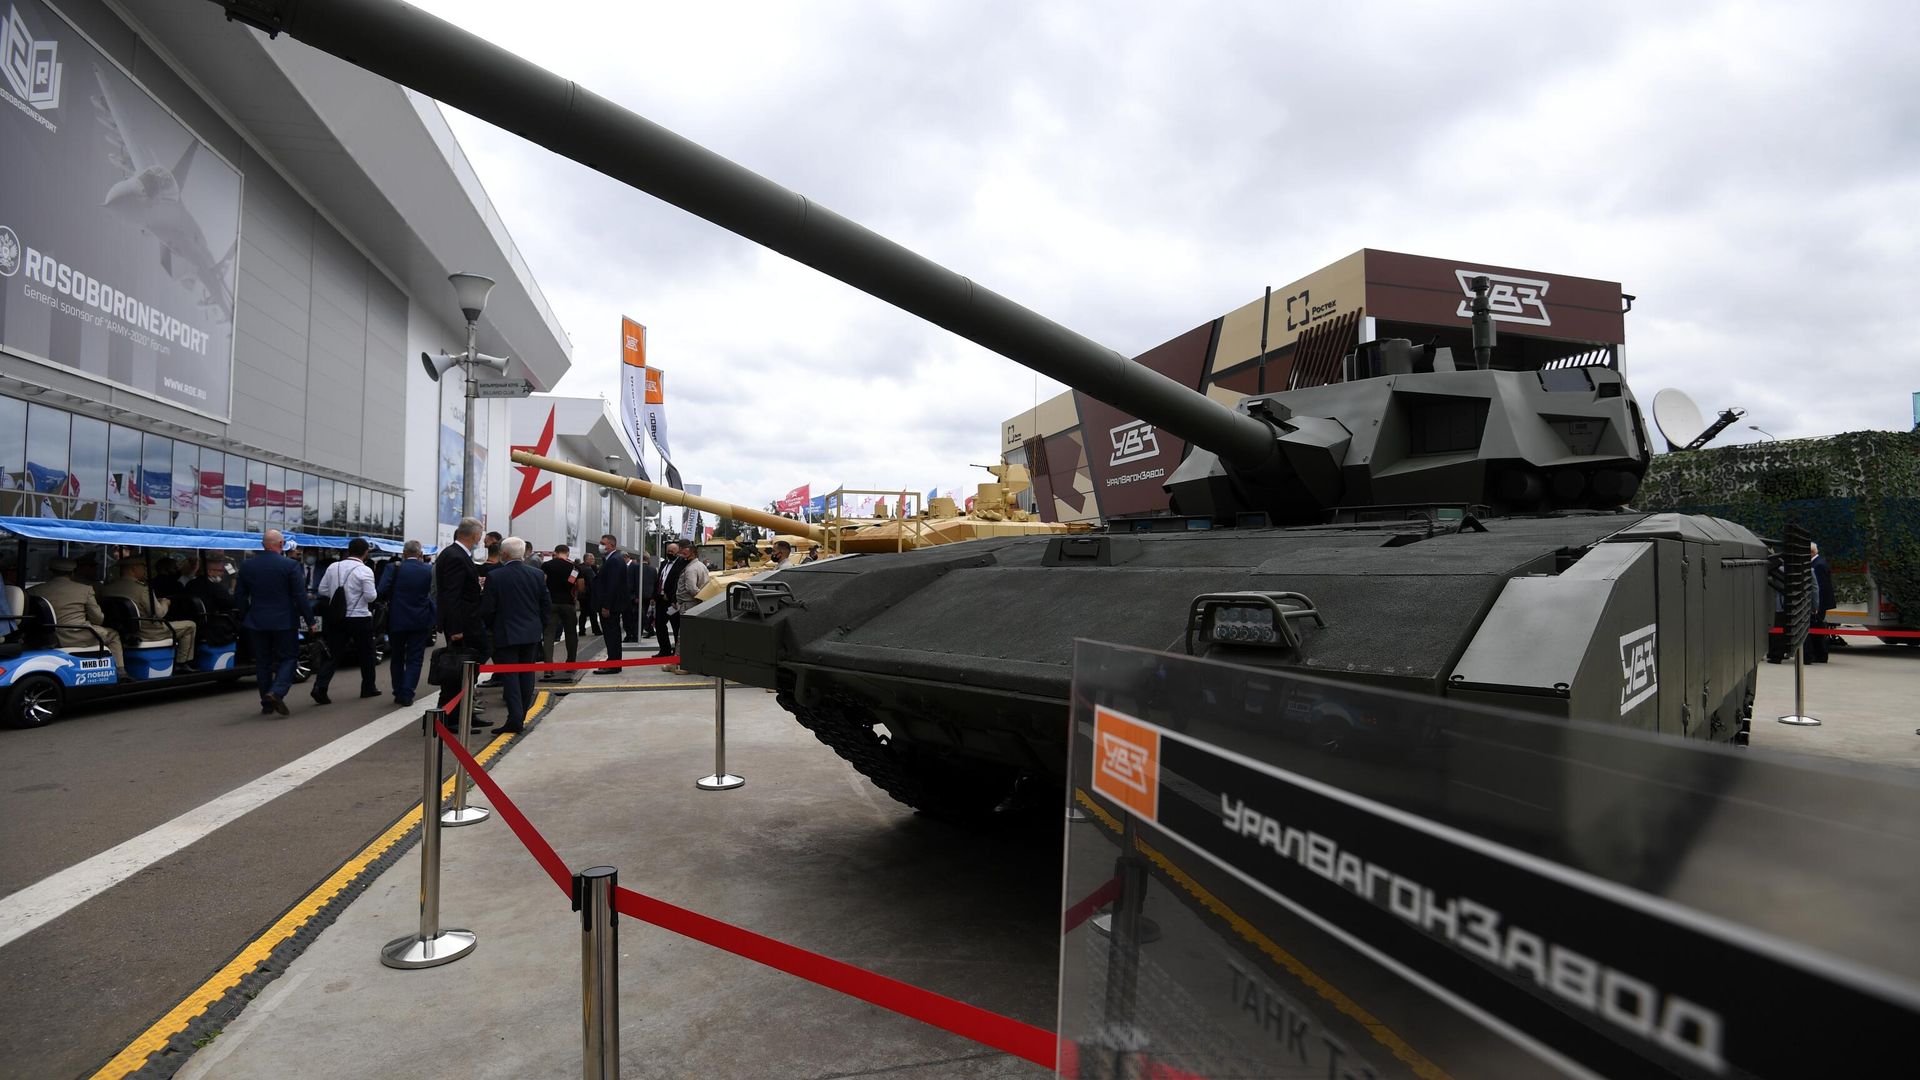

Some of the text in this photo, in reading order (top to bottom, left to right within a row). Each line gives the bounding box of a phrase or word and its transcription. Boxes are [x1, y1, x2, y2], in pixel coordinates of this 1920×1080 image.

[0, 87, 57, 134] OSOBORONEXPORT
[24, 284, 58, 309] General
[60, 302, 94, 322] sponsor
[94, 316, 104, 326] of
[25, 246, 209, 356] ROSOBORONEXPORT
[1228, 963, 1308, 1064] ТАНК
